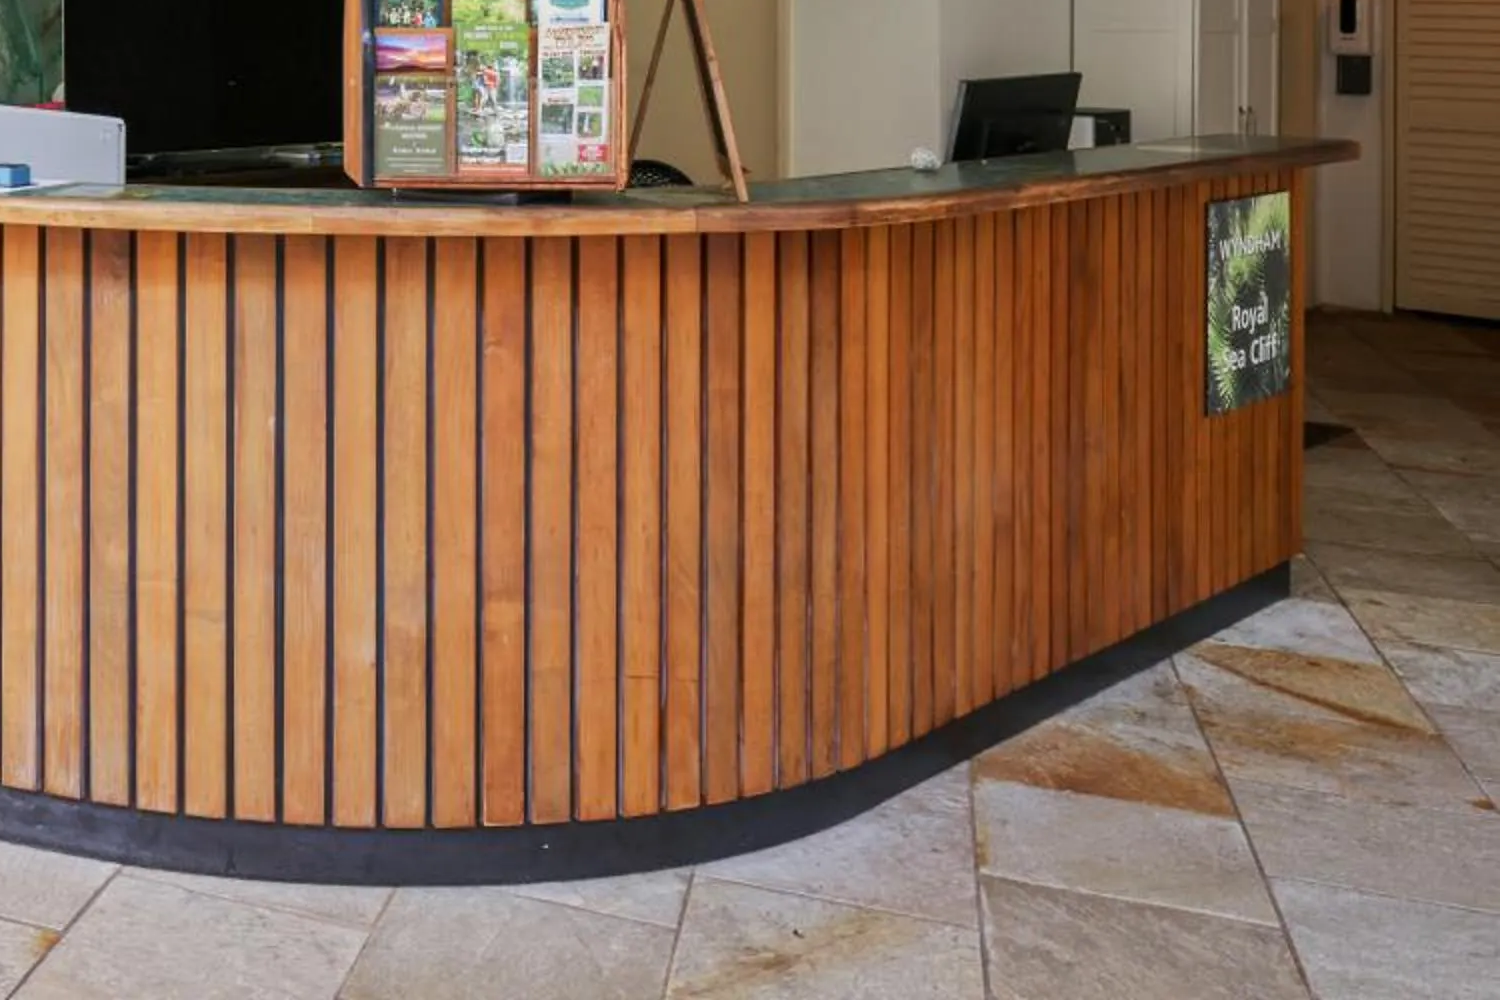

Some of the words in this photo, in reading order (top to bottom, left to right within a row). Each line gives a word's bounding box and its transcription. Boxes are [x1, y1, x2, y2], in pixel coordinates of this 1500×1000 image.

[1219, 230, 1281, 261] WYNDHAM
[1231, 291, 1268, 335] Royal
[1251, 332, 1280, 365] Cliff
